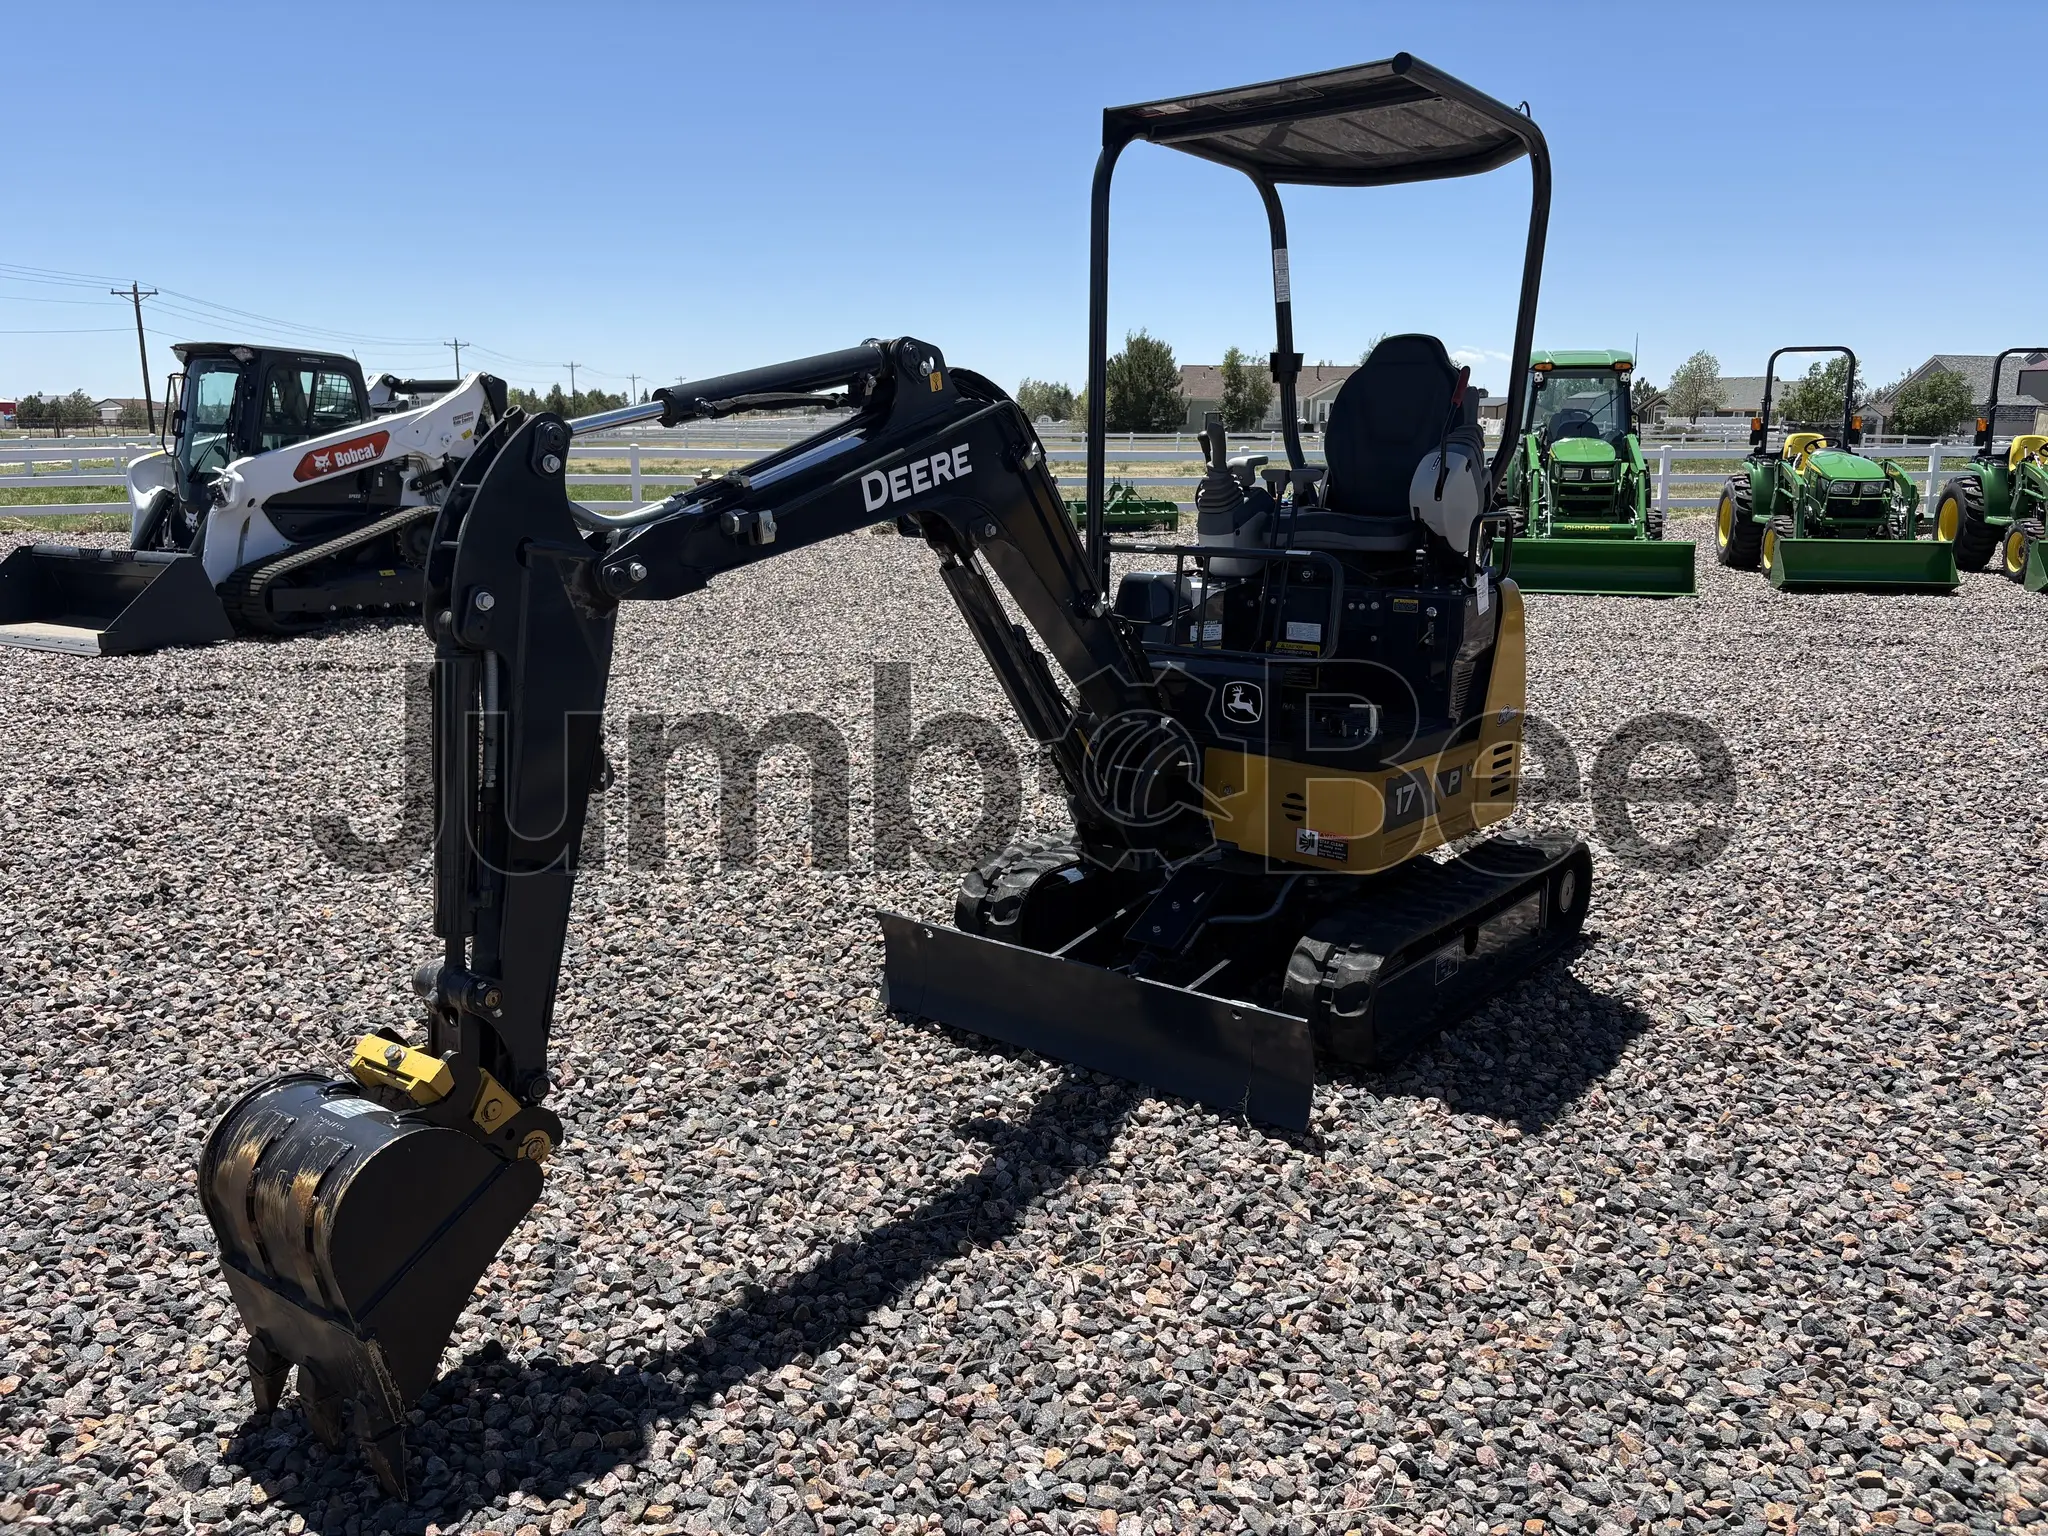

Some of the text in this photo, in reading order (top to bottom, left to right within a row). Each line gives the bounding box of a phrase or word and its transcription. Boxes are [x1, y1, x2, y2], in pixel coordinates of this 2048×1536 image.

[334, 443, 376, 468] Bobcat
[861, 442, 972, 513] DEERE
[1395, 769, 1461, 816] 17 P
